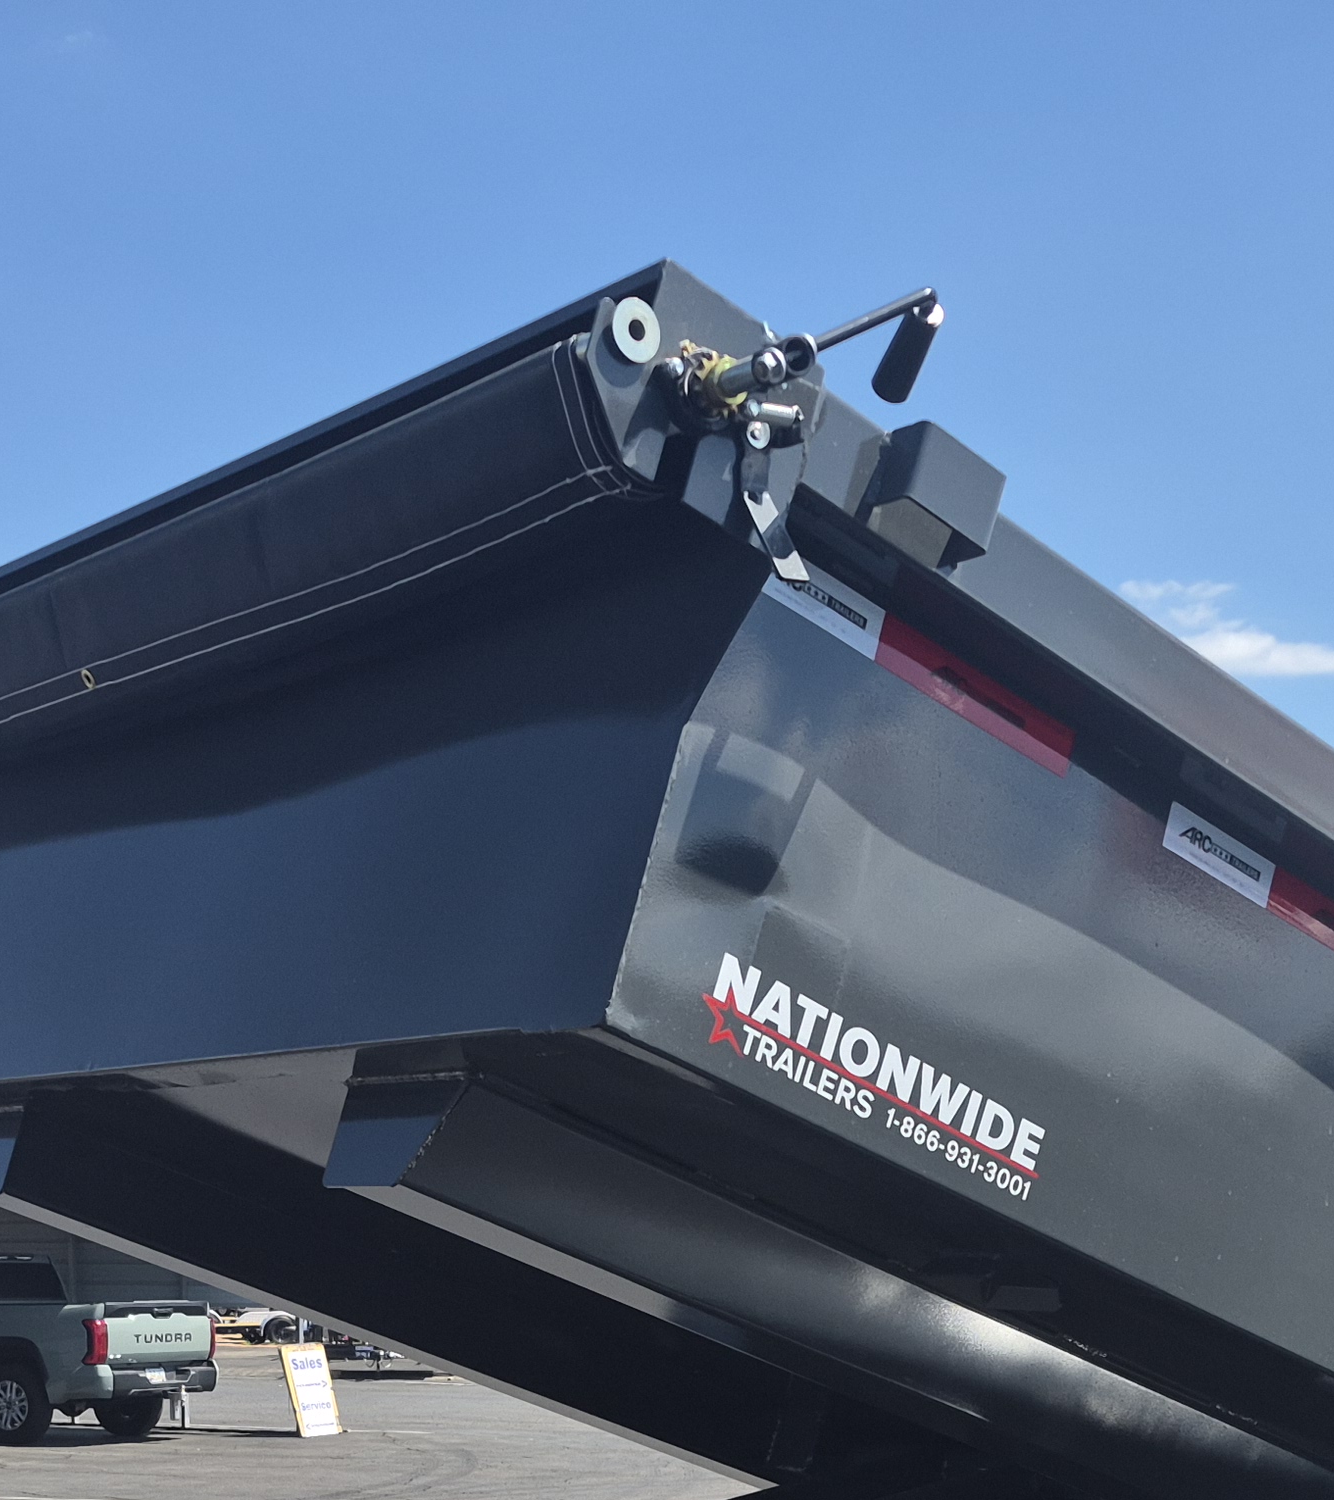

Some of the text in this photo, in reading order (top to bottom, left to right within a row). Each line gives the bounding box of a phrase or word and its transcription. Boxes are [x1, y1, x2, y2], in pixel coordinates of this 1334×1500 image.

[1179, 826, 1213, 854] ARC
[712, 951, 1047, 1172] NATIONWIDE
[741, 1024, 1032, 1201] TRAILERS 1-866-931-3001
[134, 1333, 192, 1343] TUNDRA
[291, 1357, 323, 1371] Sales
